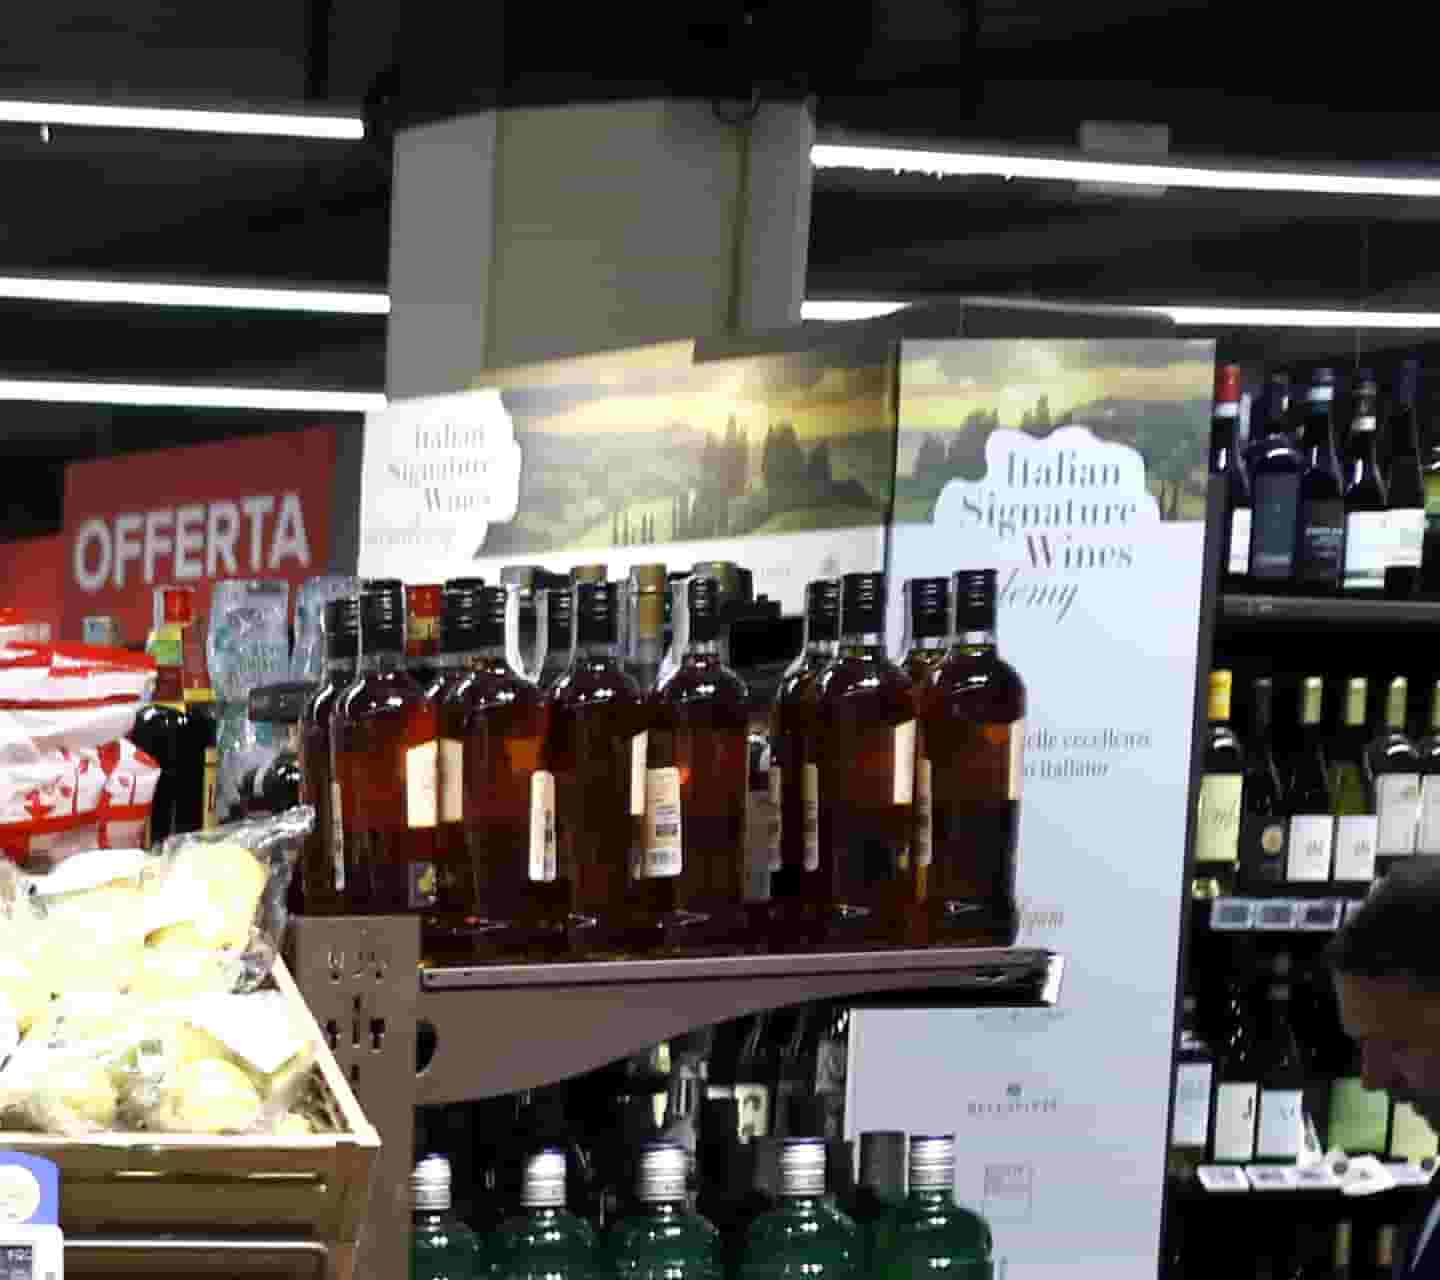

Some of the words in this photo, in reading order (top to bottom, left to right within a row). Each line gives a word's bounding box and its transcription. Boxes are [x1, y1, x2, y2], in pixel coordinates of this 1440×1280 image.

[415, 422, 486, 449] Italian
[386, 455, 490, 489] Signature
[1006, 450, 1120, 487] Italian
[422, 488, 491, 514] Wines
[958, 491, 1137, 539] Signature
[74, 489, 311, 592] OFFERTA
[1024, 533, 1135, 570] Wines
